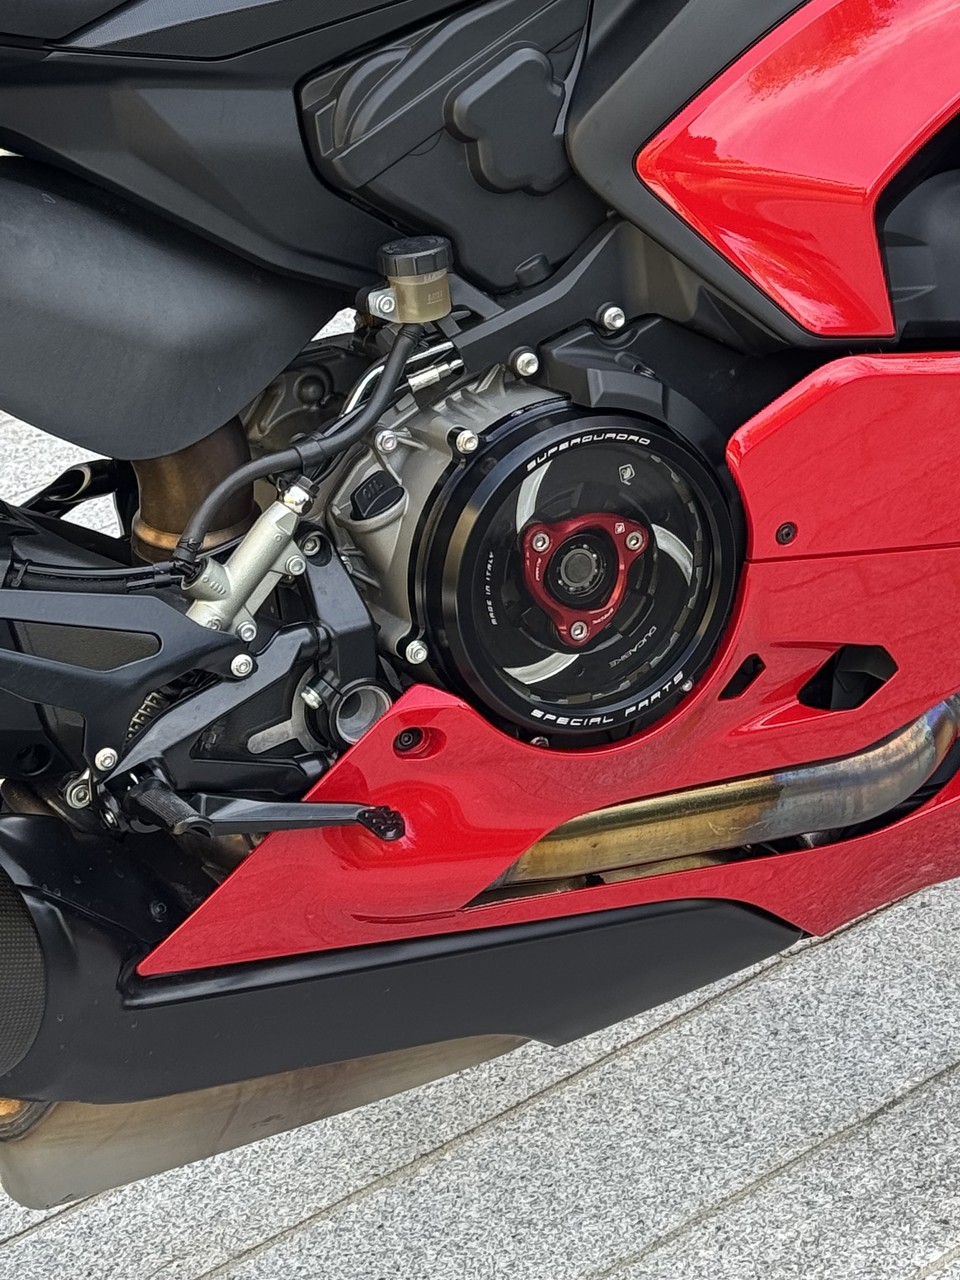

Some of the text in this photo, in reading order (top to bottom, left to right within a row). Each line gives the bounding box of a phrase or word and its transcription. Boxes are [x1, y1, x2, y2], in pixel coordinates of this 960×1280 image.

[526, 433, 651, 472] SUPERQUADRO
[362, 479, 384, 500] OIL
[485, 552, 498, 625] MADE IN ITALY
[530, 671, 684, 727] SPECIAL PARTS
